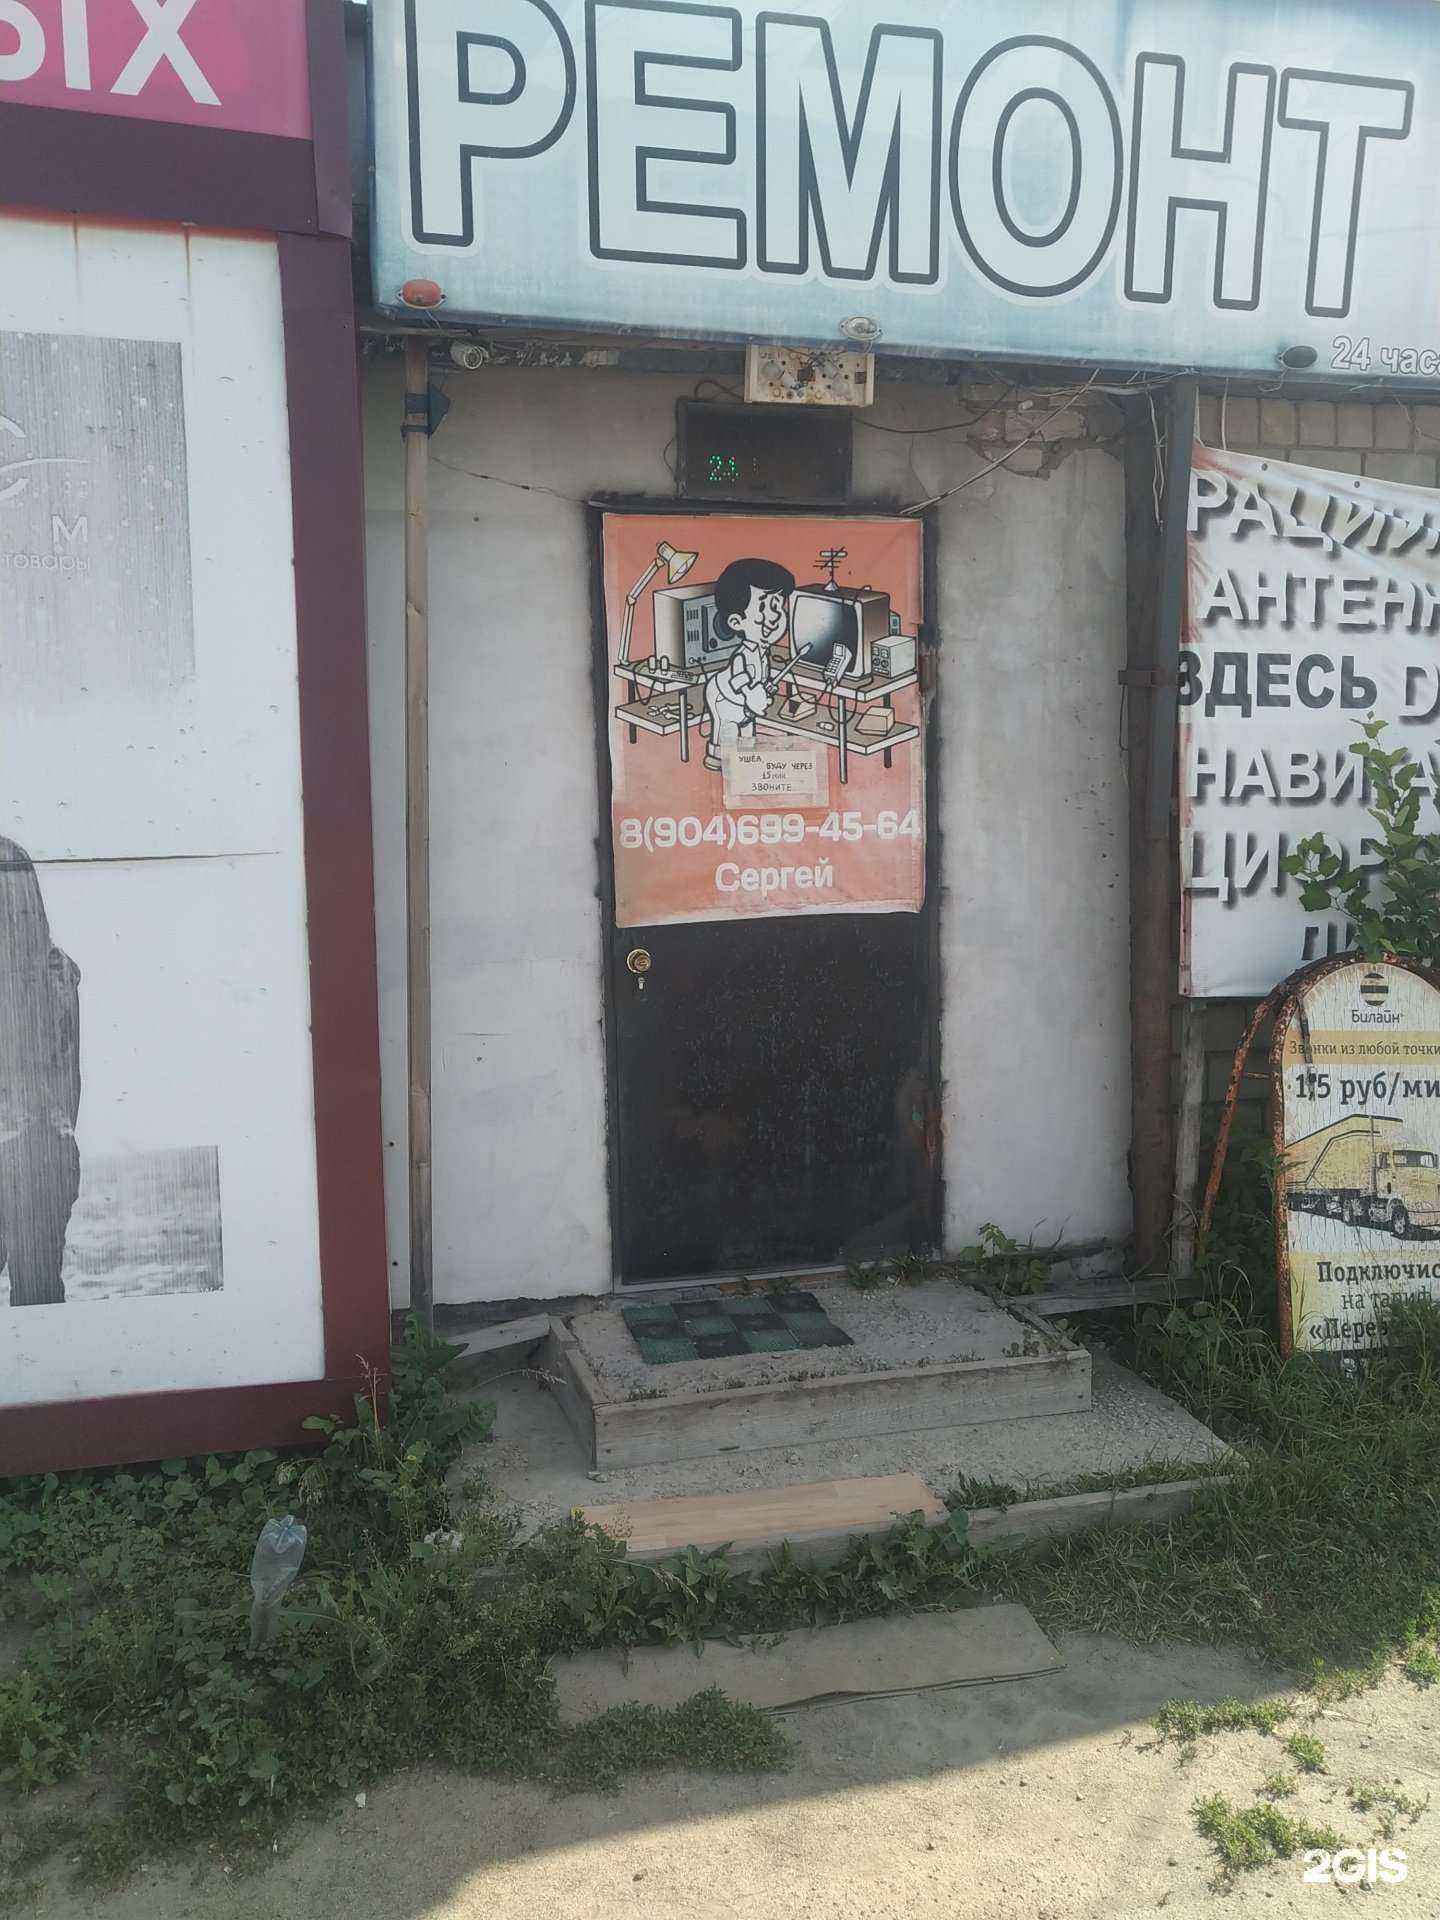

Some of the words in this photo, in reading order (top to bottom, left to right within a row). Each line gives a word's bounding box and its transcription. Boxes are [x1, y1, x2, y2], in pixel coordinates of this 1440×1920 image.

[404, 0, 1415, 319] РЕМОНТ
[1330, 335, 1371, 371] 24
[1380, 347, 1440, 375] час
[1178, 650, 1378, 718] ЗДЕСЬ
[752, 782, 792, 792] ЗВОНИТЕ
[619, 810, 922, 853] 8(904)699-45-64
[715, 857, 833, 897] Сергей
[1351, 1009, 1400, 1024] Билайн
[1289, 1041, 1337, 1055] Звнки
[1341, 1044, 1355, 1055] из
[1358, 1041, 1399, 1056] любой
